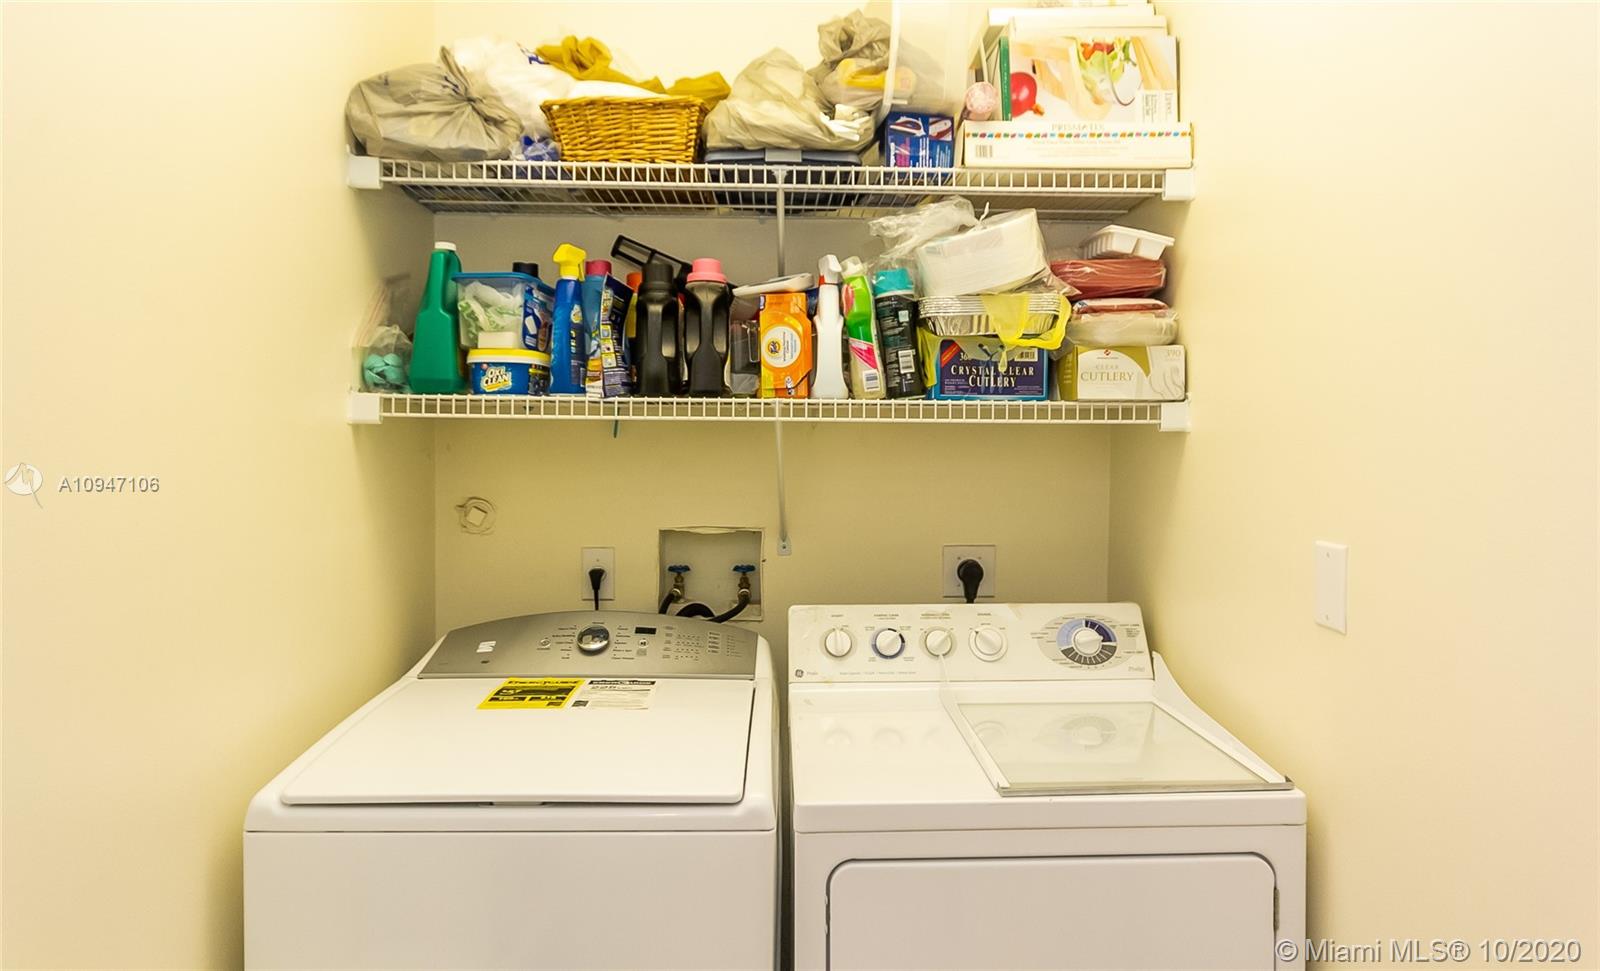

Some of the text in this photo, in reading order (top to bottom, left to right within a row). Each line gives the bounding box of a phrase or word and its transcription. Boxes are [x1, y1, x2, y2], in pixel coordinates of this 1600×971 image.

[488, 367, 504, 378] OXI
[951, 364, 1034, 376] CRYSTAL CLEAR
[968, 375, 1017, 388] CUTLERY
[1080, 371, 1134, 382] CUTLERY
